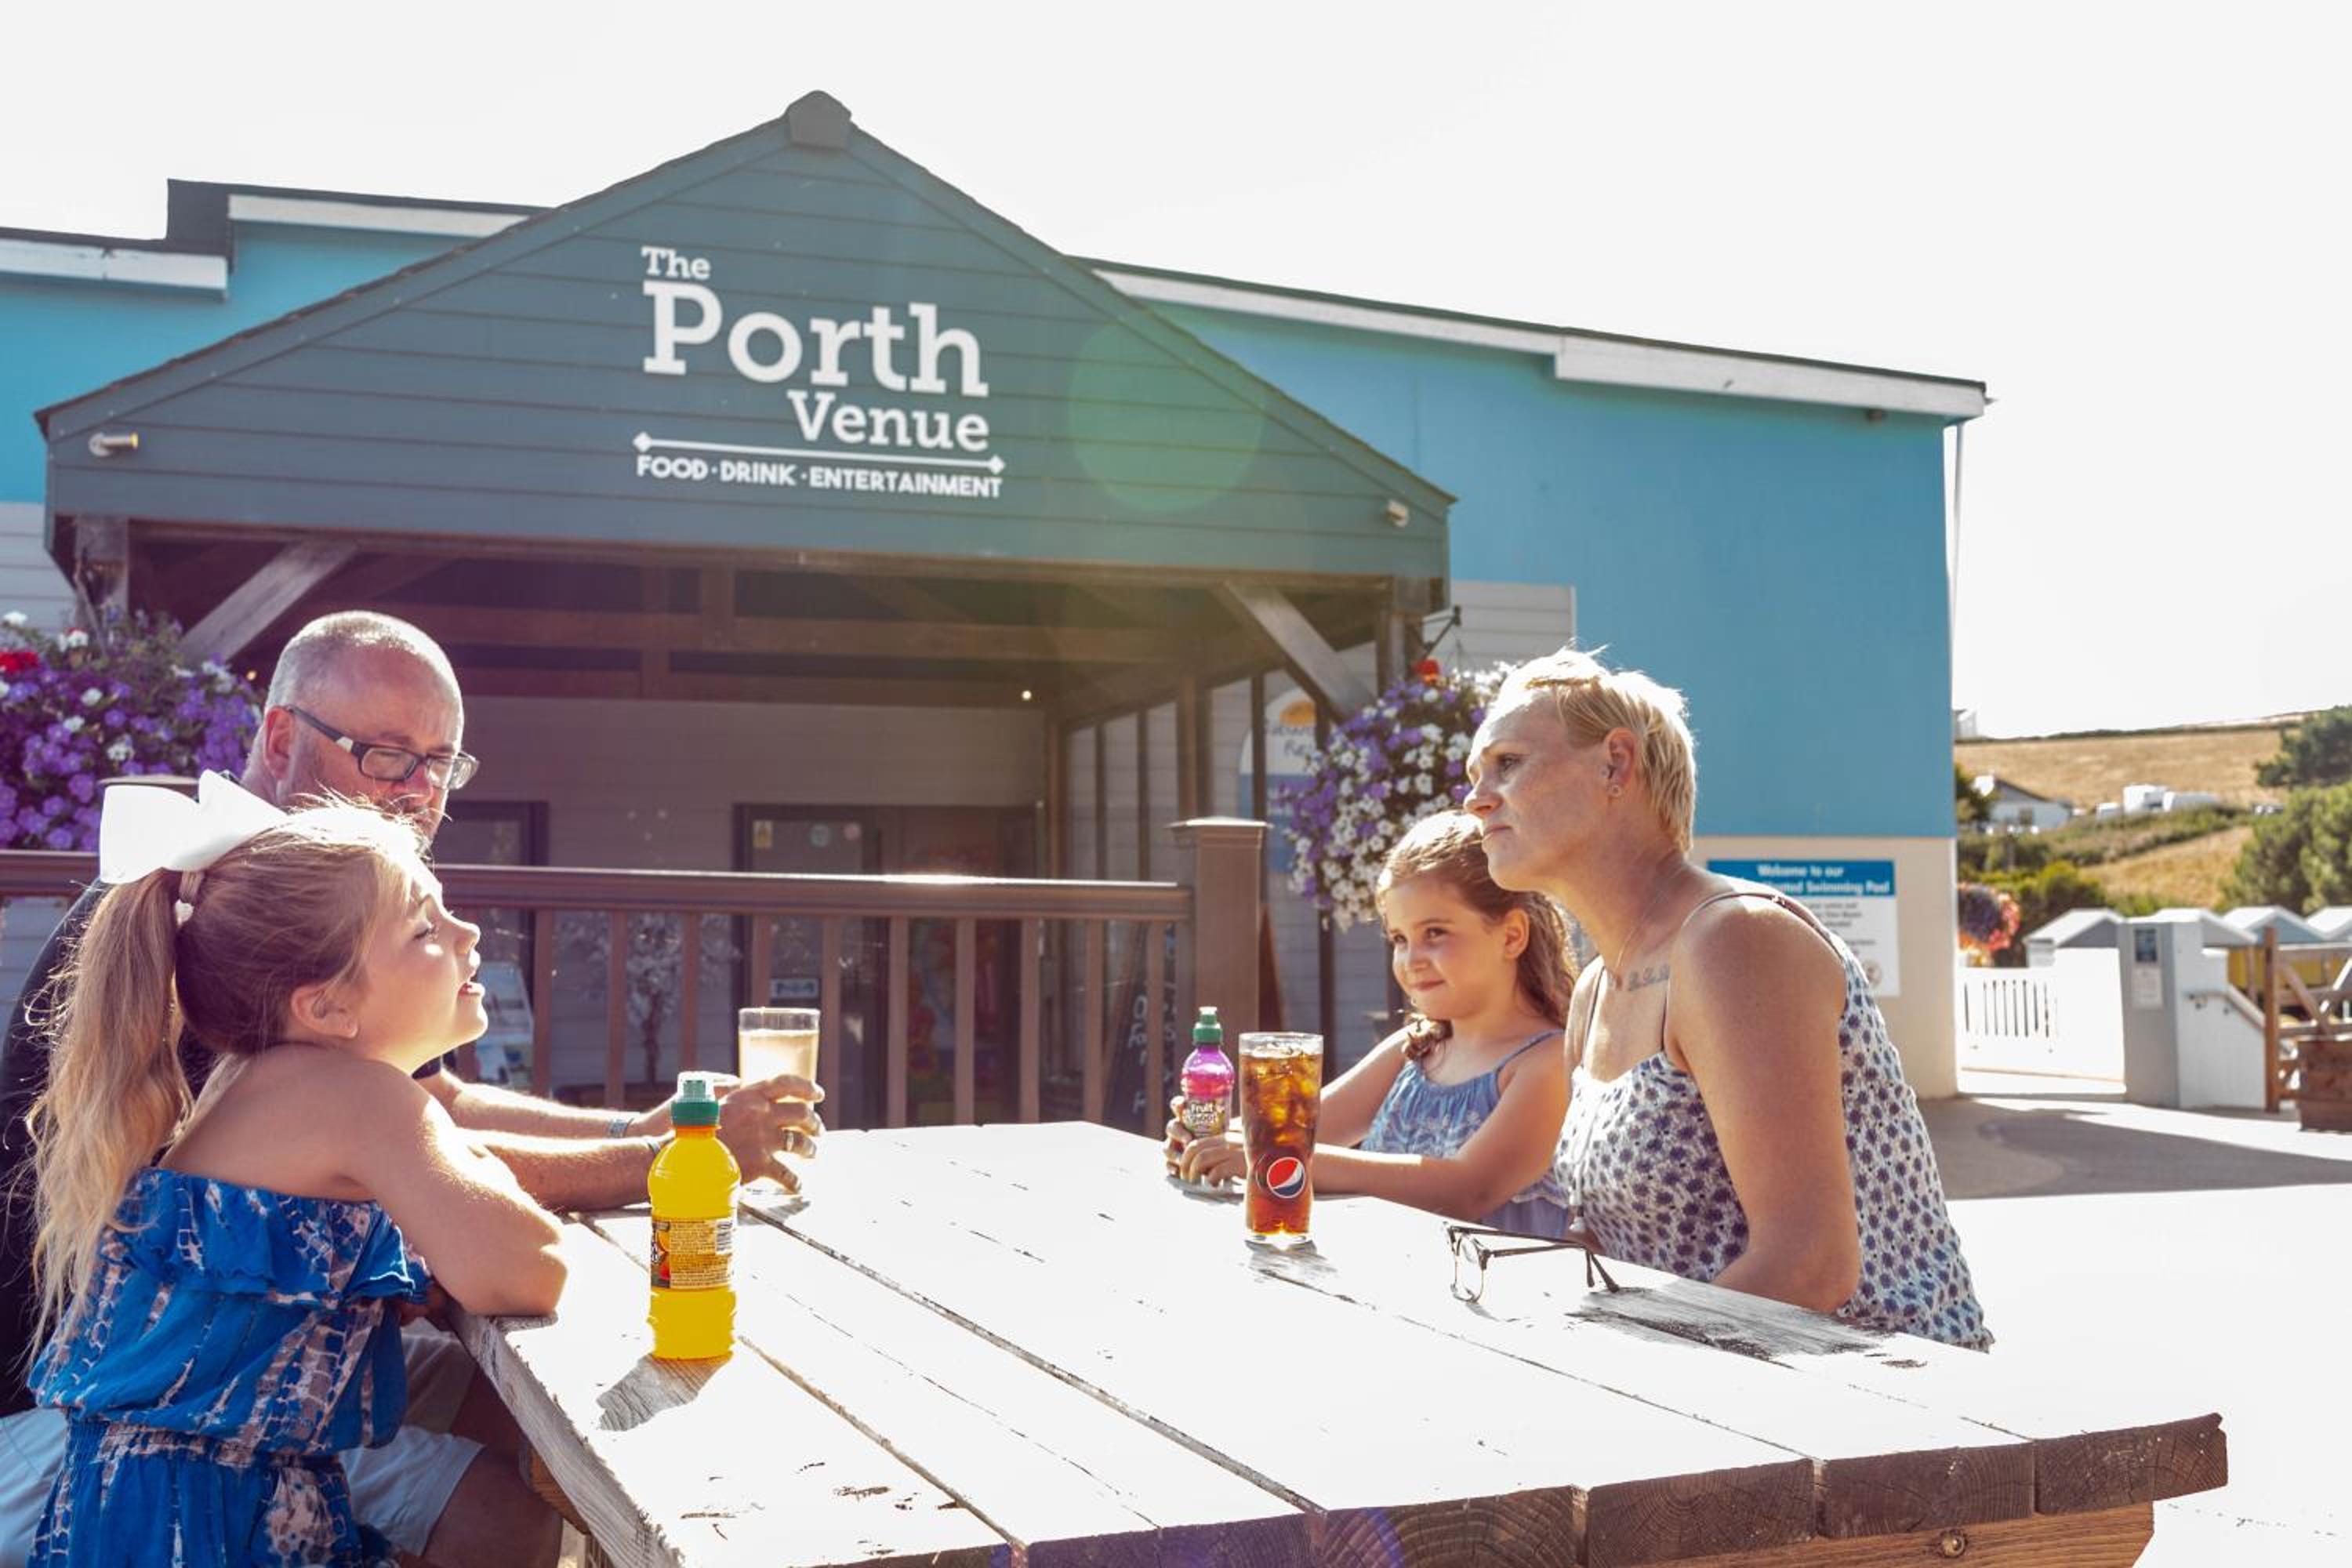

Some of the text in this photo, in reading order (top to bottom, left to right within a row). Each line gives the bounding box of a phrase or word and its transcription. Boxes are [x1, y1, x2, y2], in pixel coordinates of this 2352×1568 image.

[641, 246, 710, 280] The
[643, 280, 989, 397] Porth
[786, 390, 989, 452] Venue
[637, 455, 1003, 498] FOOD DRINK ENTERTAINMENT
[1757, 864, 1844, 877] Welcome to our
[1806, 880, 1864, 895] Swimming
[1865, 880, 1890, 893] Pool
